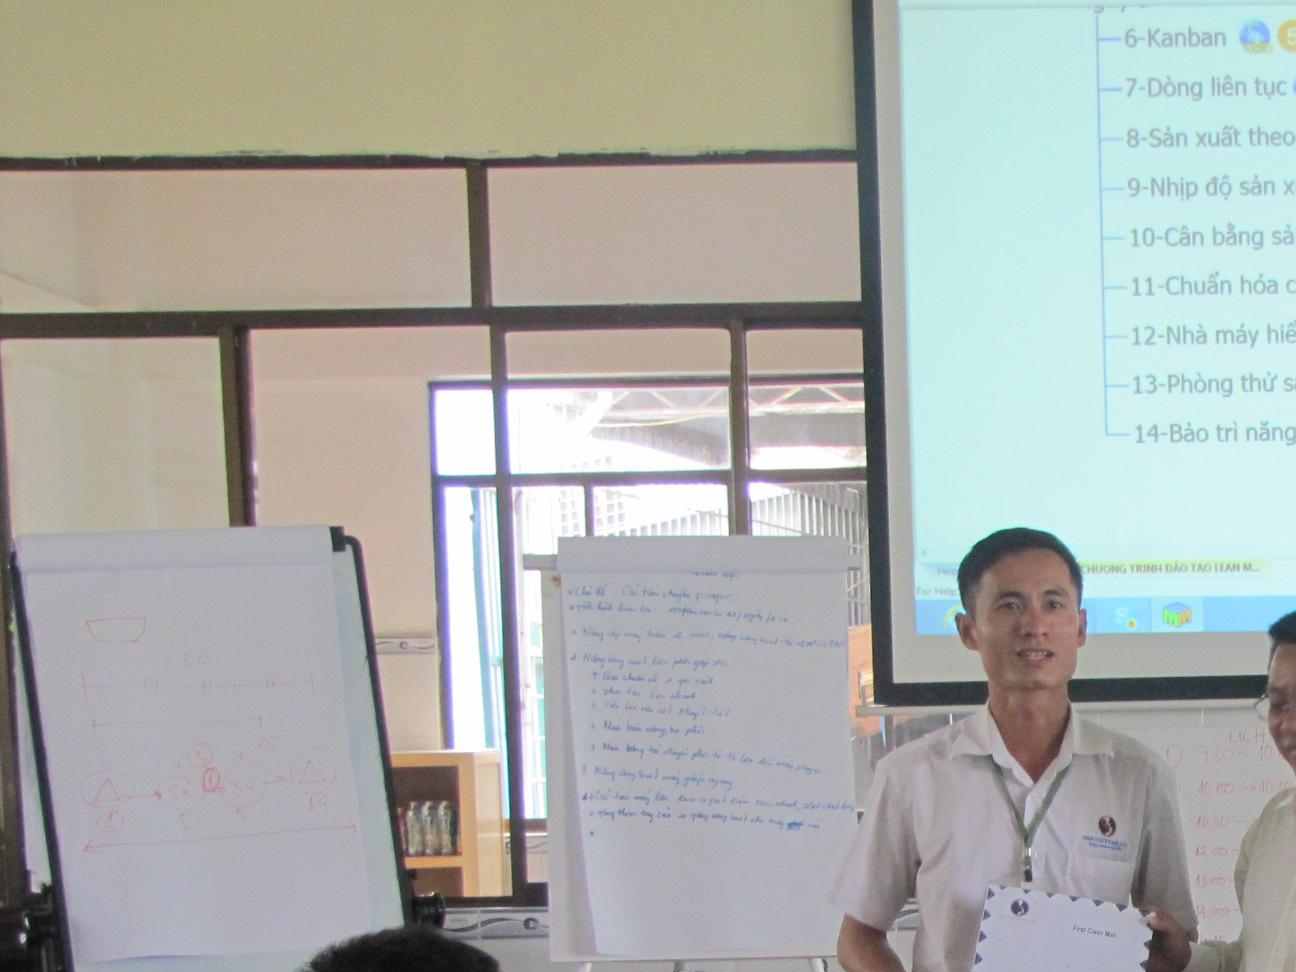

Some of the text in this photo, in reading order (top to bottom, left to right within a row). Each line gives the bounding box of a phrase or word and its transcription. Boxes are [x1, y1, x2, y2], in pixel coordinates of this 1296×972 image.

[1124, 27, 1226, 48] 6-Kanban
[1125, 76, 1287, 101] 7-Dòng liên tục
[1126, 125, 1187, 148] 8-Sản
[1195, 123, 1241, 147] xuất
[1248, 126, 1295, 146] theo
[1128, 176, 1199, 202] 9-Nhịp
[1205, 174, 1233, 199] độ
[1239, 174, 1276, 196] sản
[1130, 226, 1204, 248] 10-Cân
[1212, 221, 1265, 252] bằng
[1131, 271, 1233, 296] 11-Chuẩn
[1240, 273, 1279, 295] hóa
[1131, 323, 1207, 346] 12-Nhà
[1215, 323, 1259, 349] máy
[1132, 372, 1233, 399] 13-Phòng
[1134, 420, 1207, 445] 14-Bảo
[1216, 420, 1238, 443] trì
[1245, 420, 1296, 447] năng
